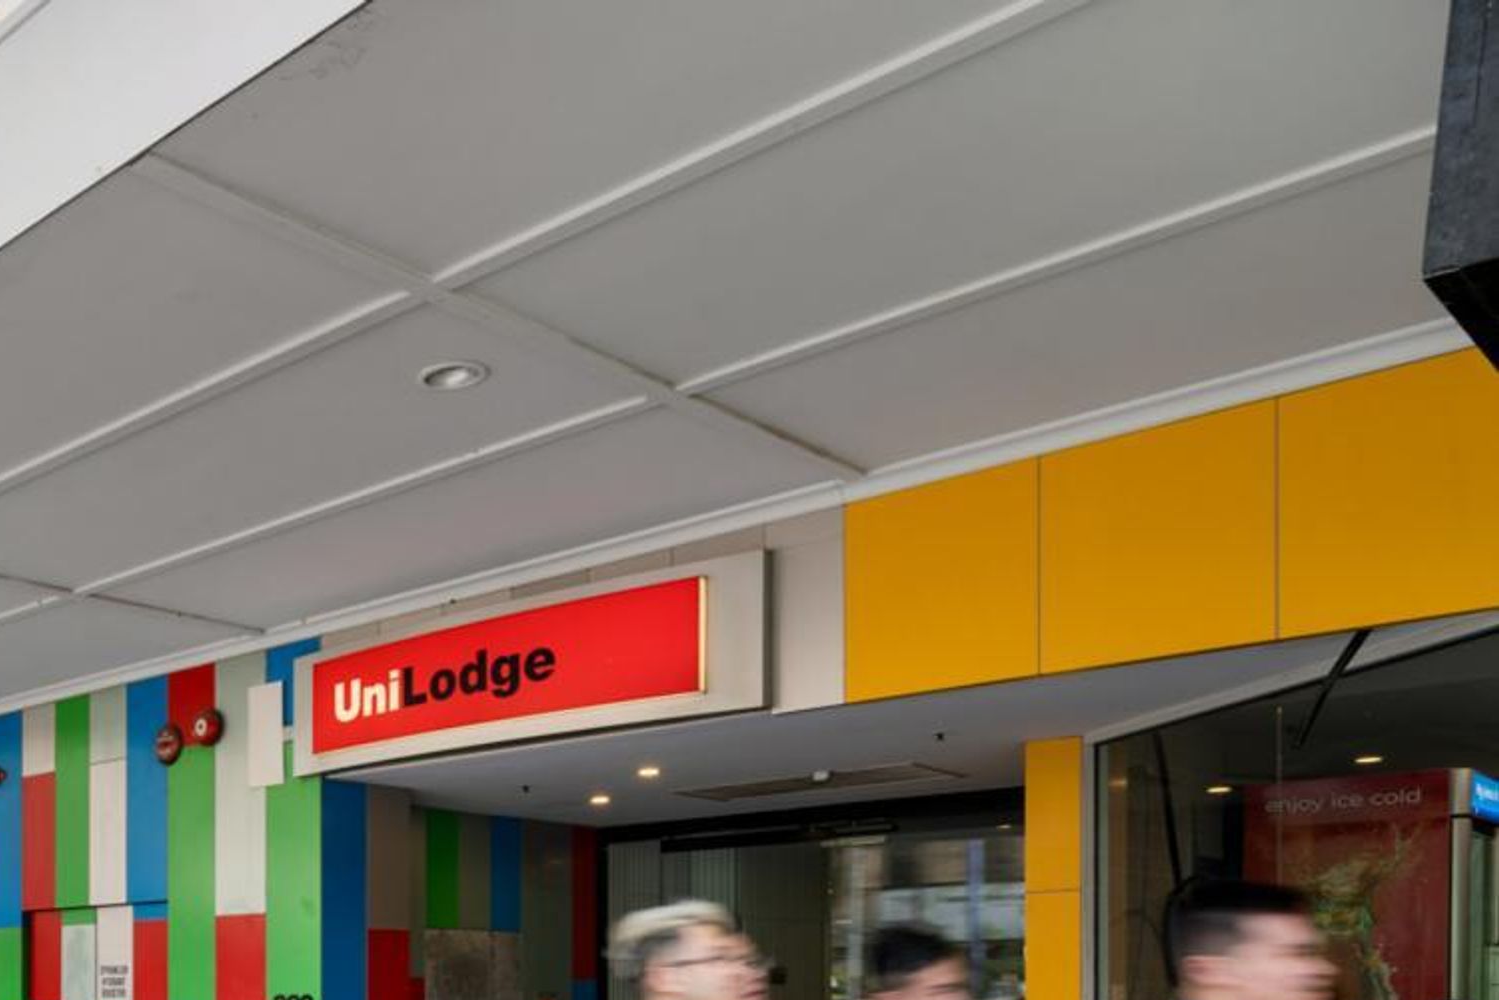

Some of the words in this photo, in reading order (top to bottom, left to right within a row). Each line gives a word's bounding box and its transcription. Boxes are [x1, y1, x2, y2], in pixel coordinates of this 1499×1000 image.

[334, 647, 556, 723] UniLodge
[1265, 797, 1323, 815] enjoy
[1330, 790, 1364, 808] ice
[1369, 785, 1421, 807] cold
